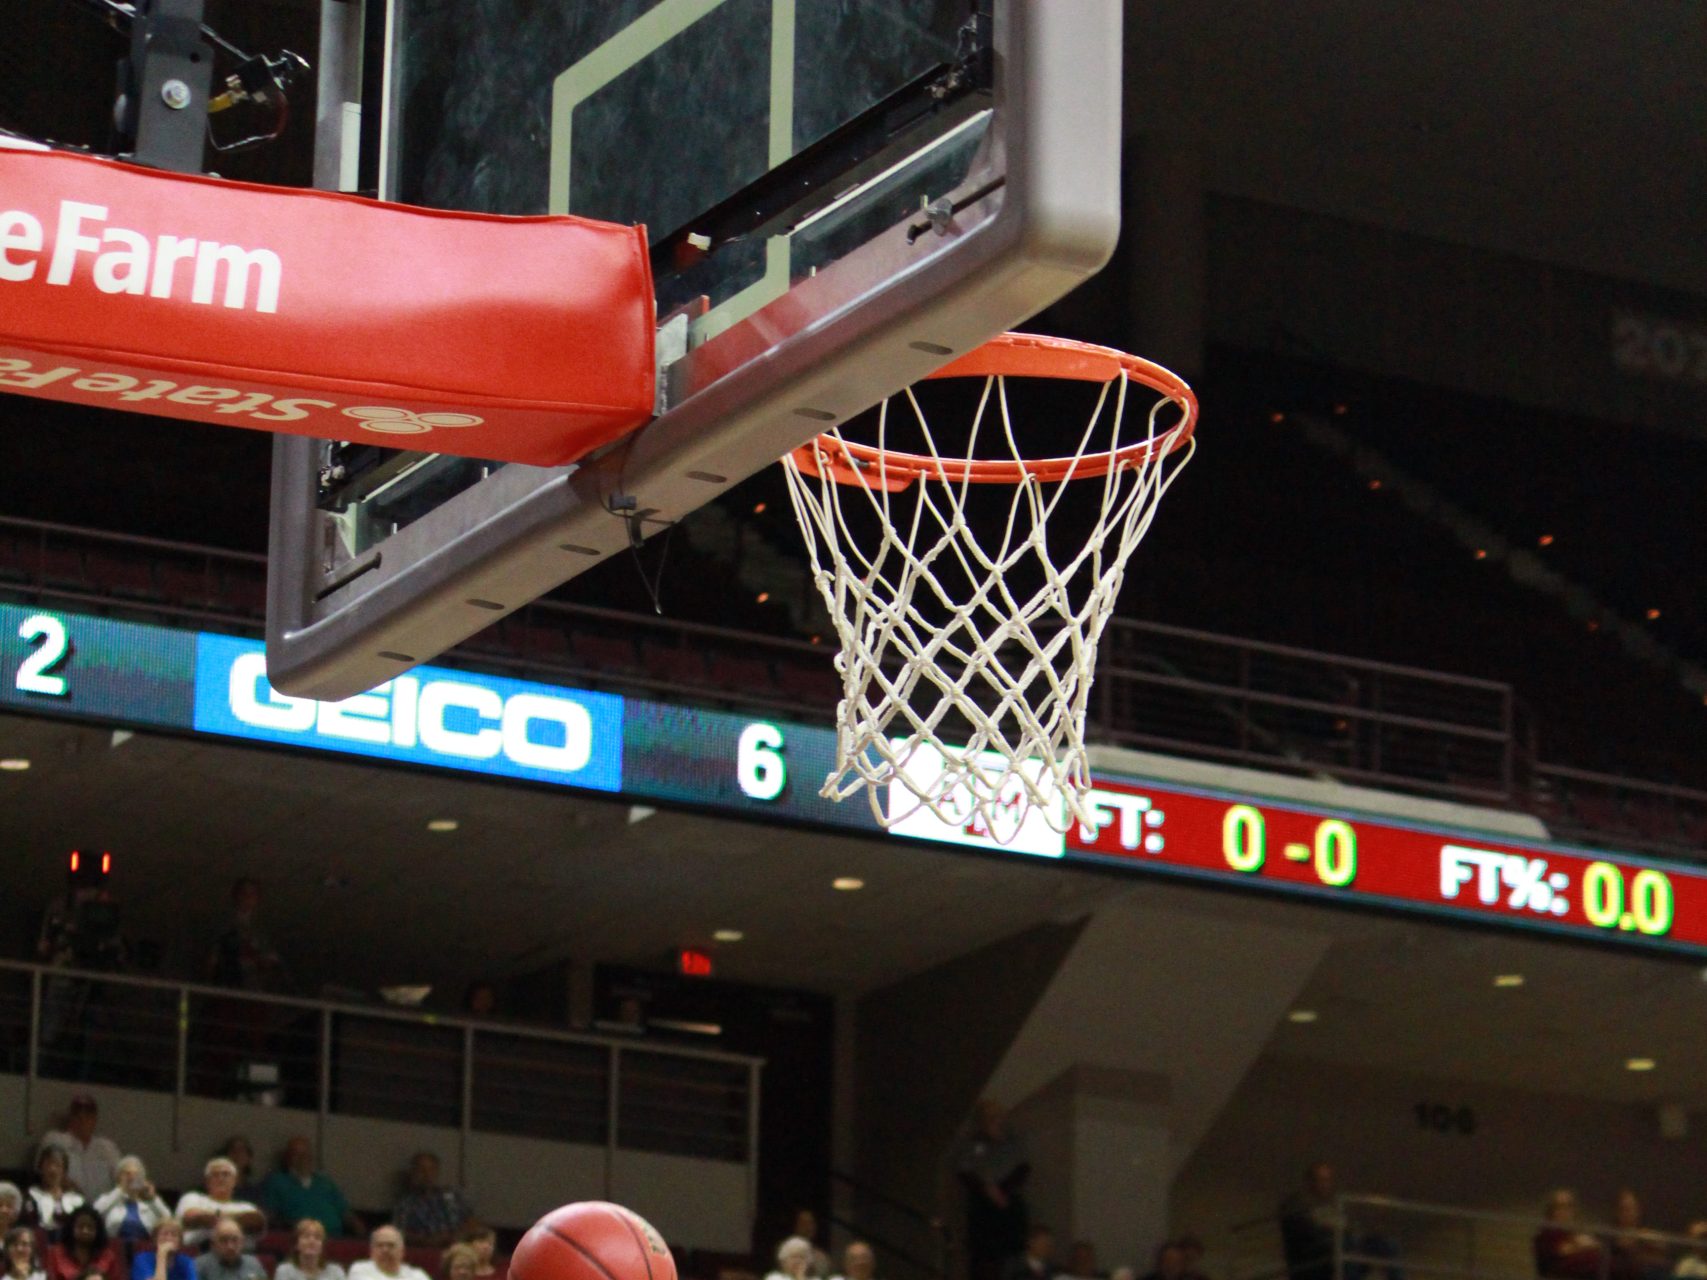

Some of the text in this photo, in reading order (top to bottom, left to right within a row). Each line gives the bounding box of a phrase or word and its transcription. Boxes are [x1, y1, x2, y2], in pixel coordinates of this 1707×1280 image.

[15, 613, 70, 697] 2
[227, 652, 594, 773] GEICO
[736, 722, 786, 801] 6
[1077, 790, 1166, 854] FT:
[1221, 803, 1267, 875] 0
[1438, 844, 1571, 915] FT%:
[1581, 860, 1675, 937] 0.0
